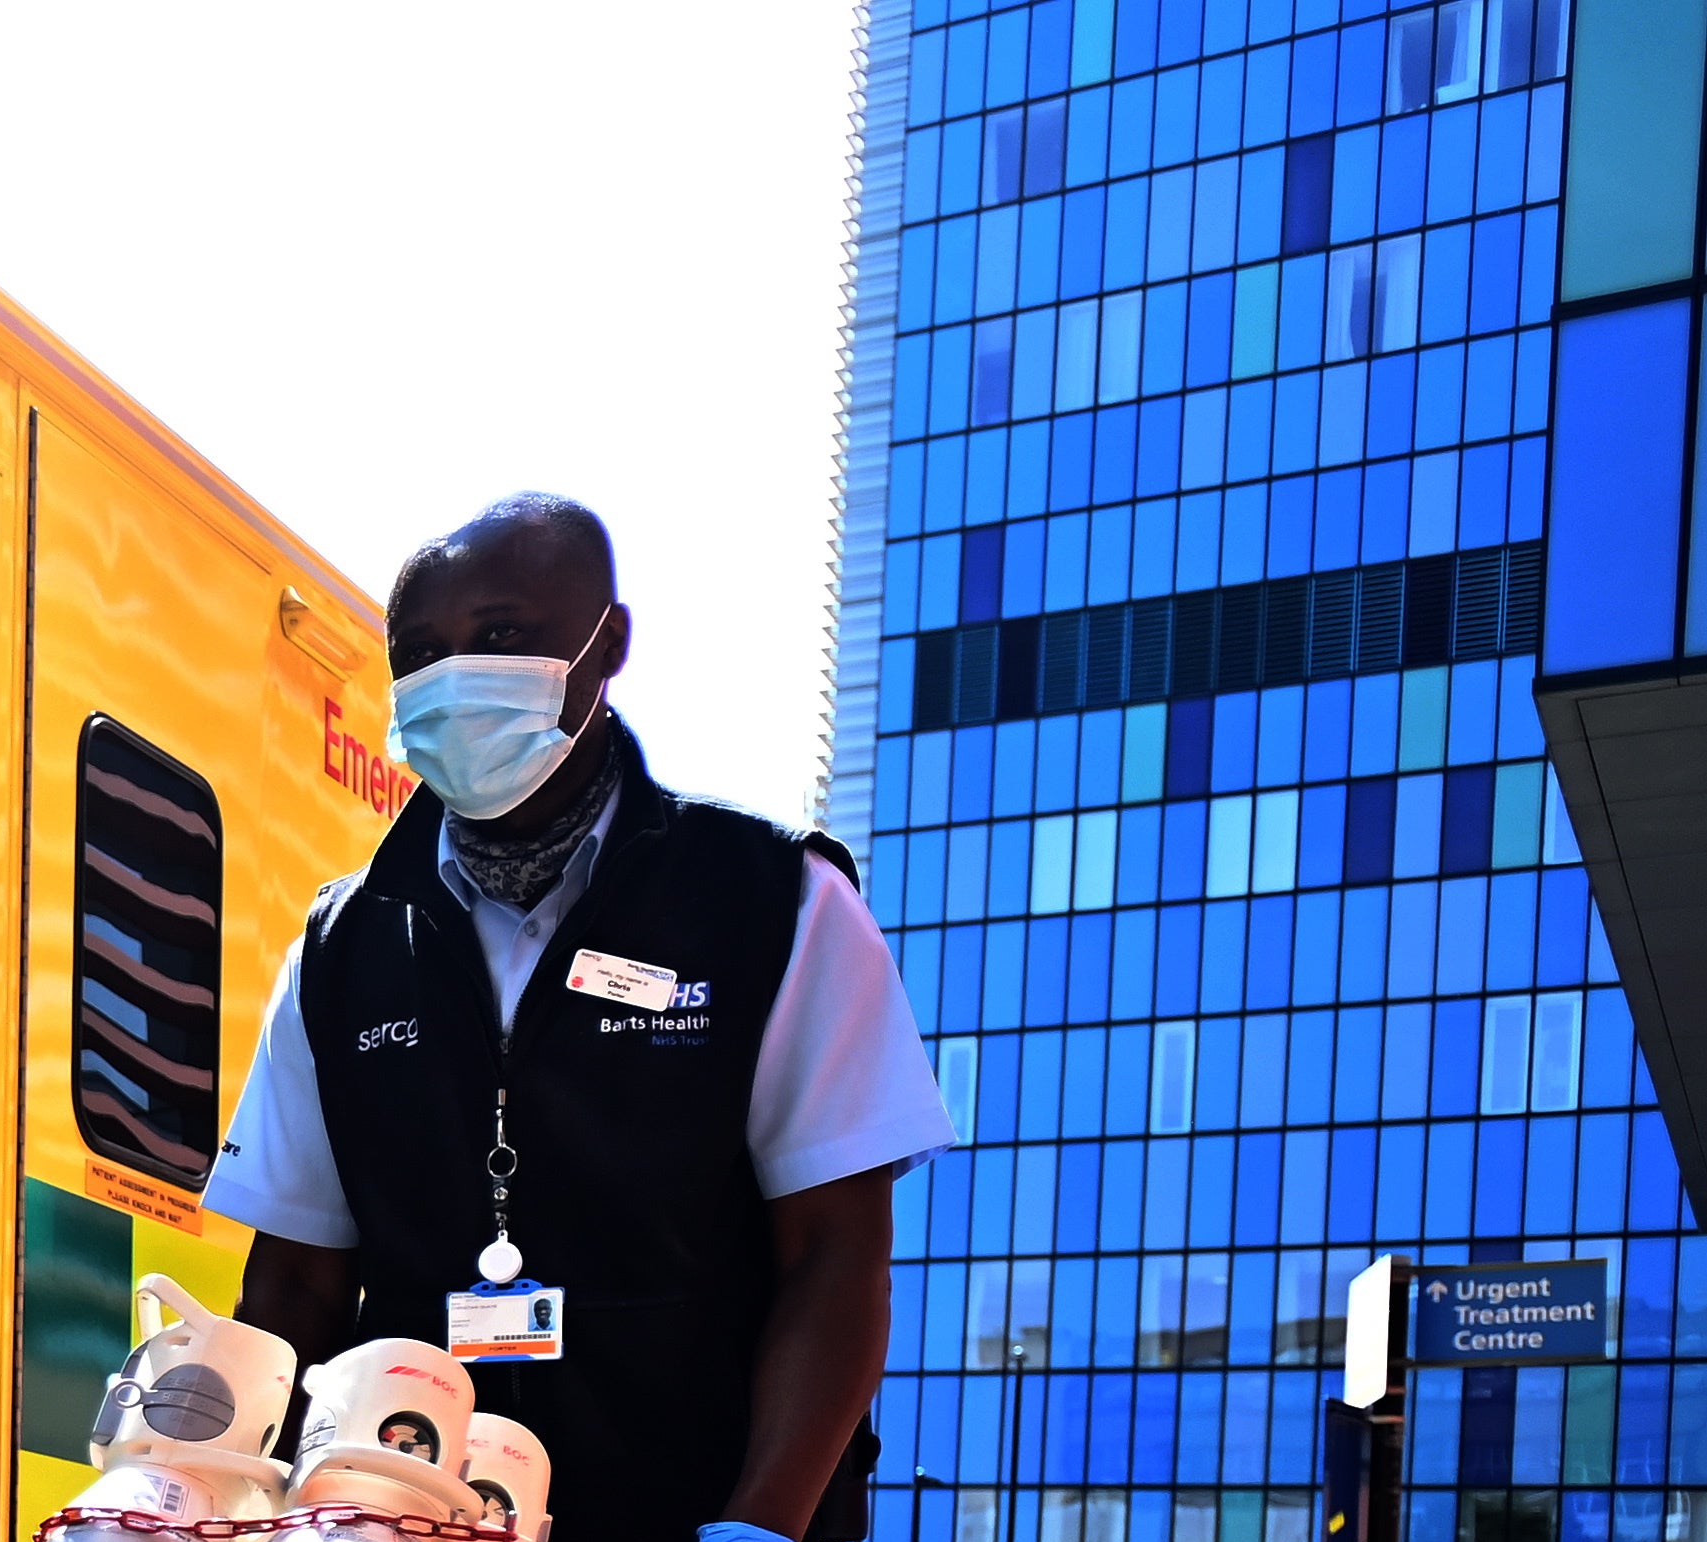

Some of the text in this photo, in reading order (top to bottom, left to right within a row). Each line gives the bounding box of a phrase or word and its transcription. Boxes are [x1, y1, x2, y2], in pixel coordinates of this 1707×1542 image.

[607, 980, 632, 993] Chris
[358, 1017, 419, 1051] serco
[600, 1014, 710, 1033] Barts Health
[651, 1035, 678, 1046] NHS
[1454, 1277, 1551, 1305] Urgent
[1453, 1301, 1596, 1326] Treatment
[1452, 1329, 1544, 1351] Centre
[432, 1375, 460, 1399] BOC
[503, 1445, 531, 1466] BOC
